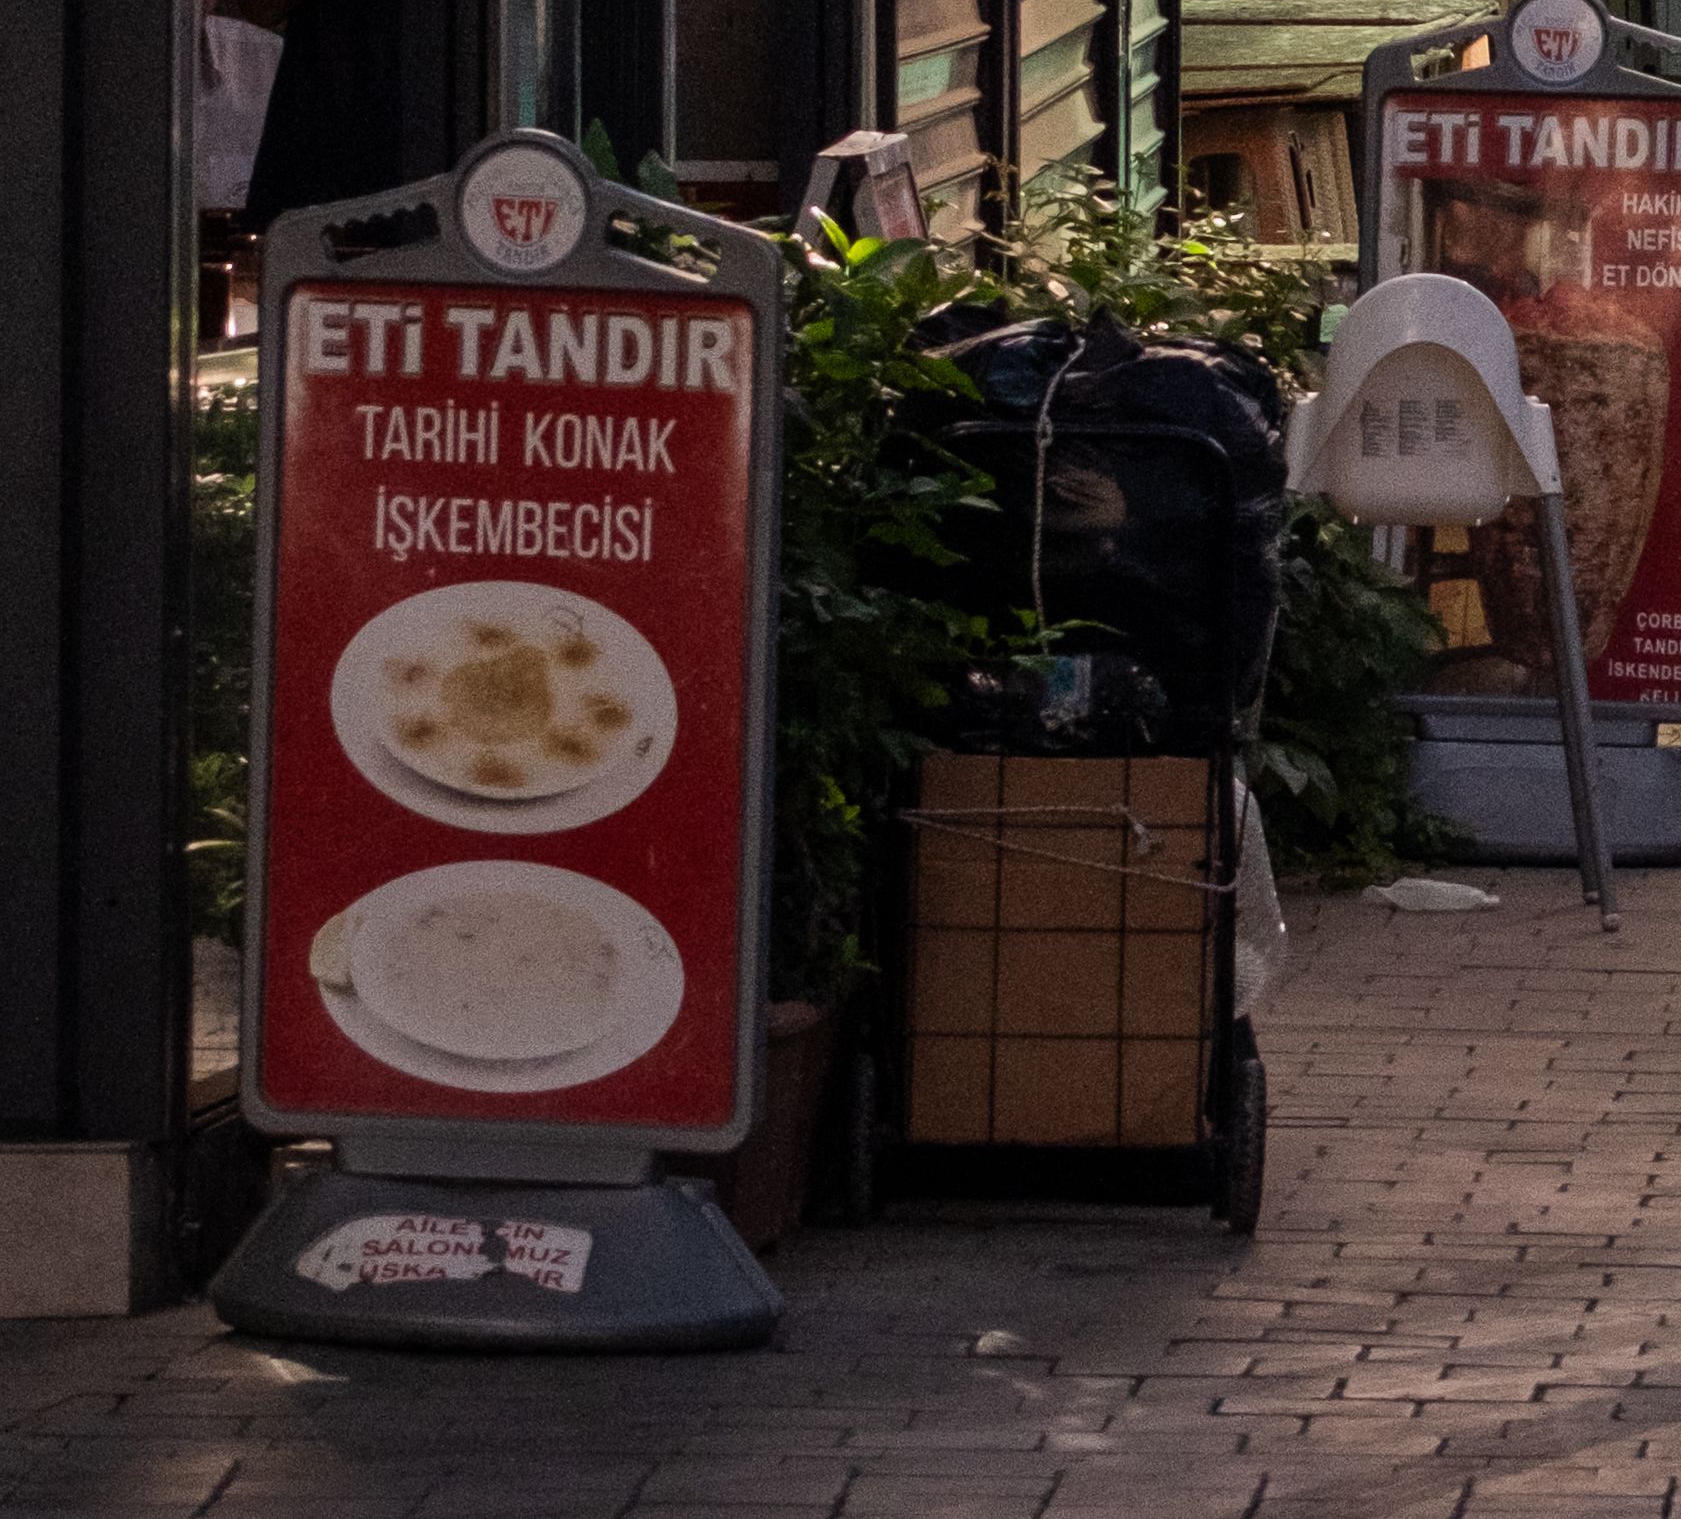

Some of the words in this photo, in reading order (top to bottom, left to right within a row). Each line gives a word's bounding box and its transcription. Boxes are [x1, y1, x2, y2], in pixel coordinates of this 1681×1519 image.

[1603, 264, 1632, 288] ET
[446, 307, 737, 393] TANDIR
[355, 399, 500, 464] TARİHİ
[524, 412, 678, 474] KONAK
[375, 486, 654, 562] İŞKEMBECİSİ
